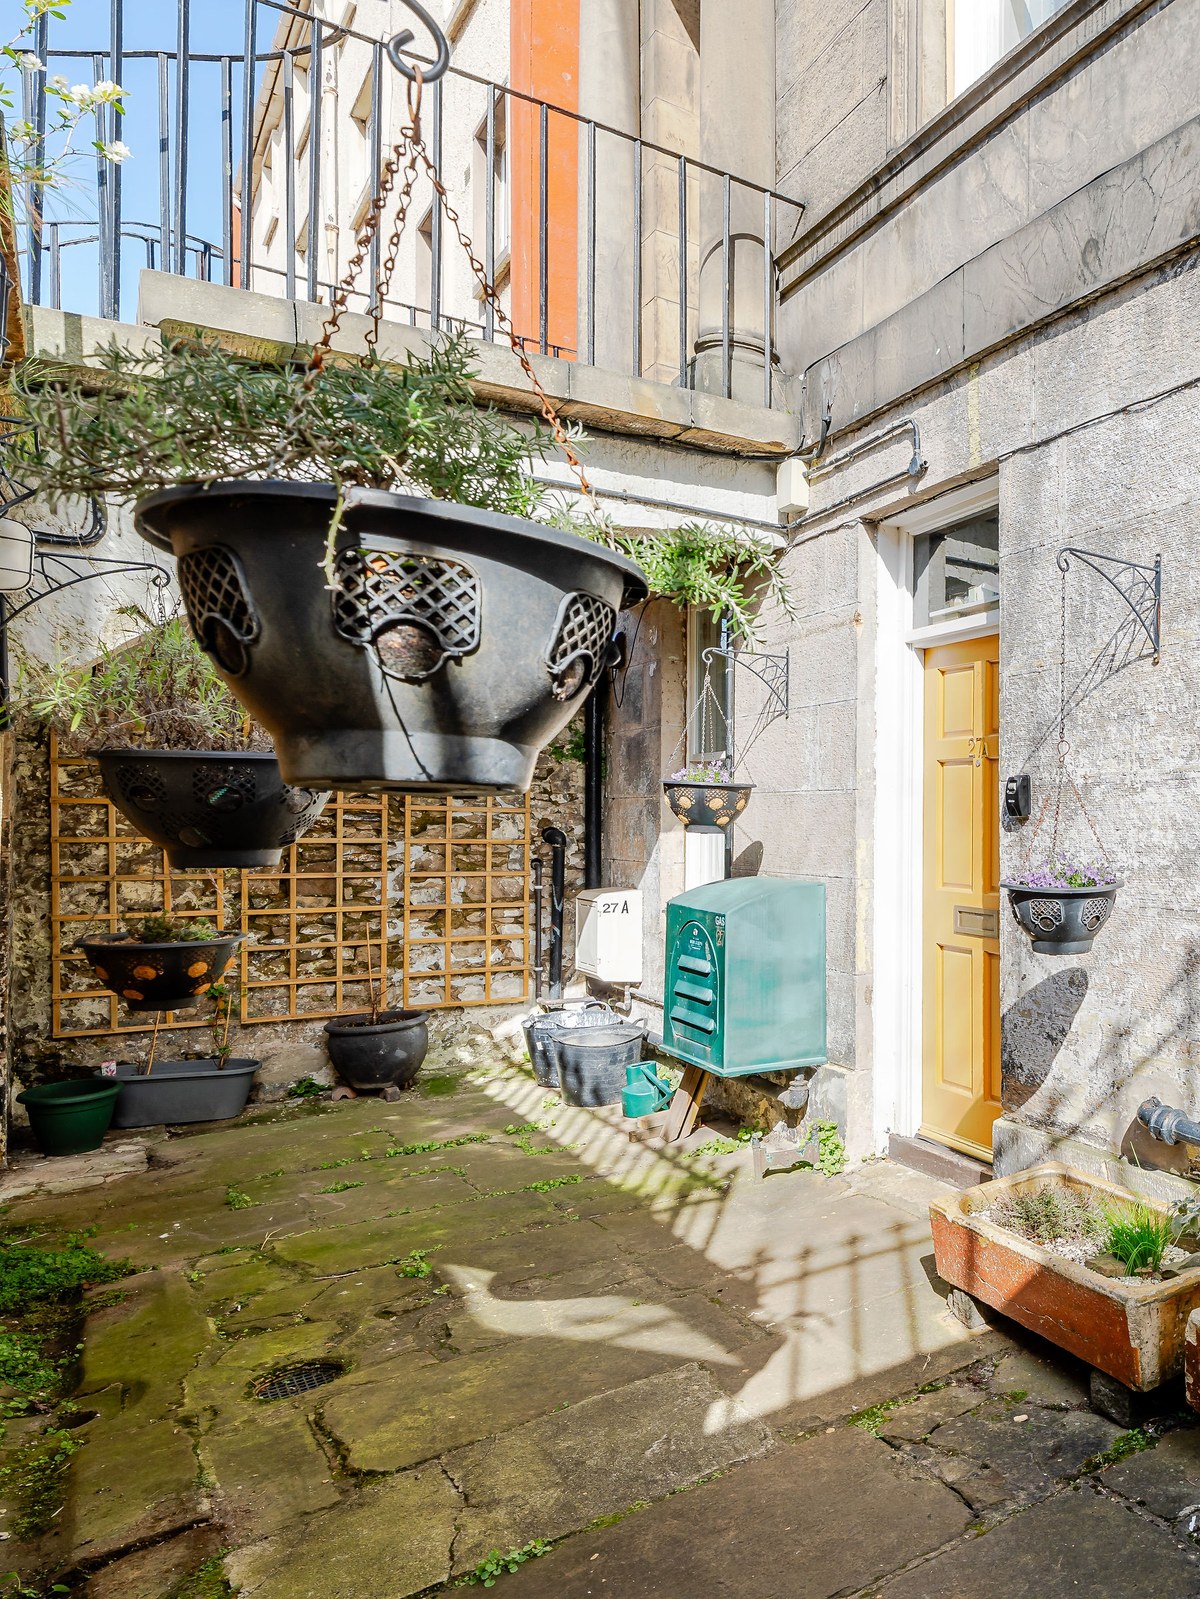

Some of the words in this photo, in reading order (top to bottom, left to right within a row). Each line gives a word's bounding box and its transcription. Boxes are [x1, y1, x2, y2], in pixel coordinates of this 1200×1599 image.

[968, 737, 988, 758] 27A
[602, 902, 619, 914] 27
[621, 900, 629, 914] A
[715, 915, 726, 927] GAS
